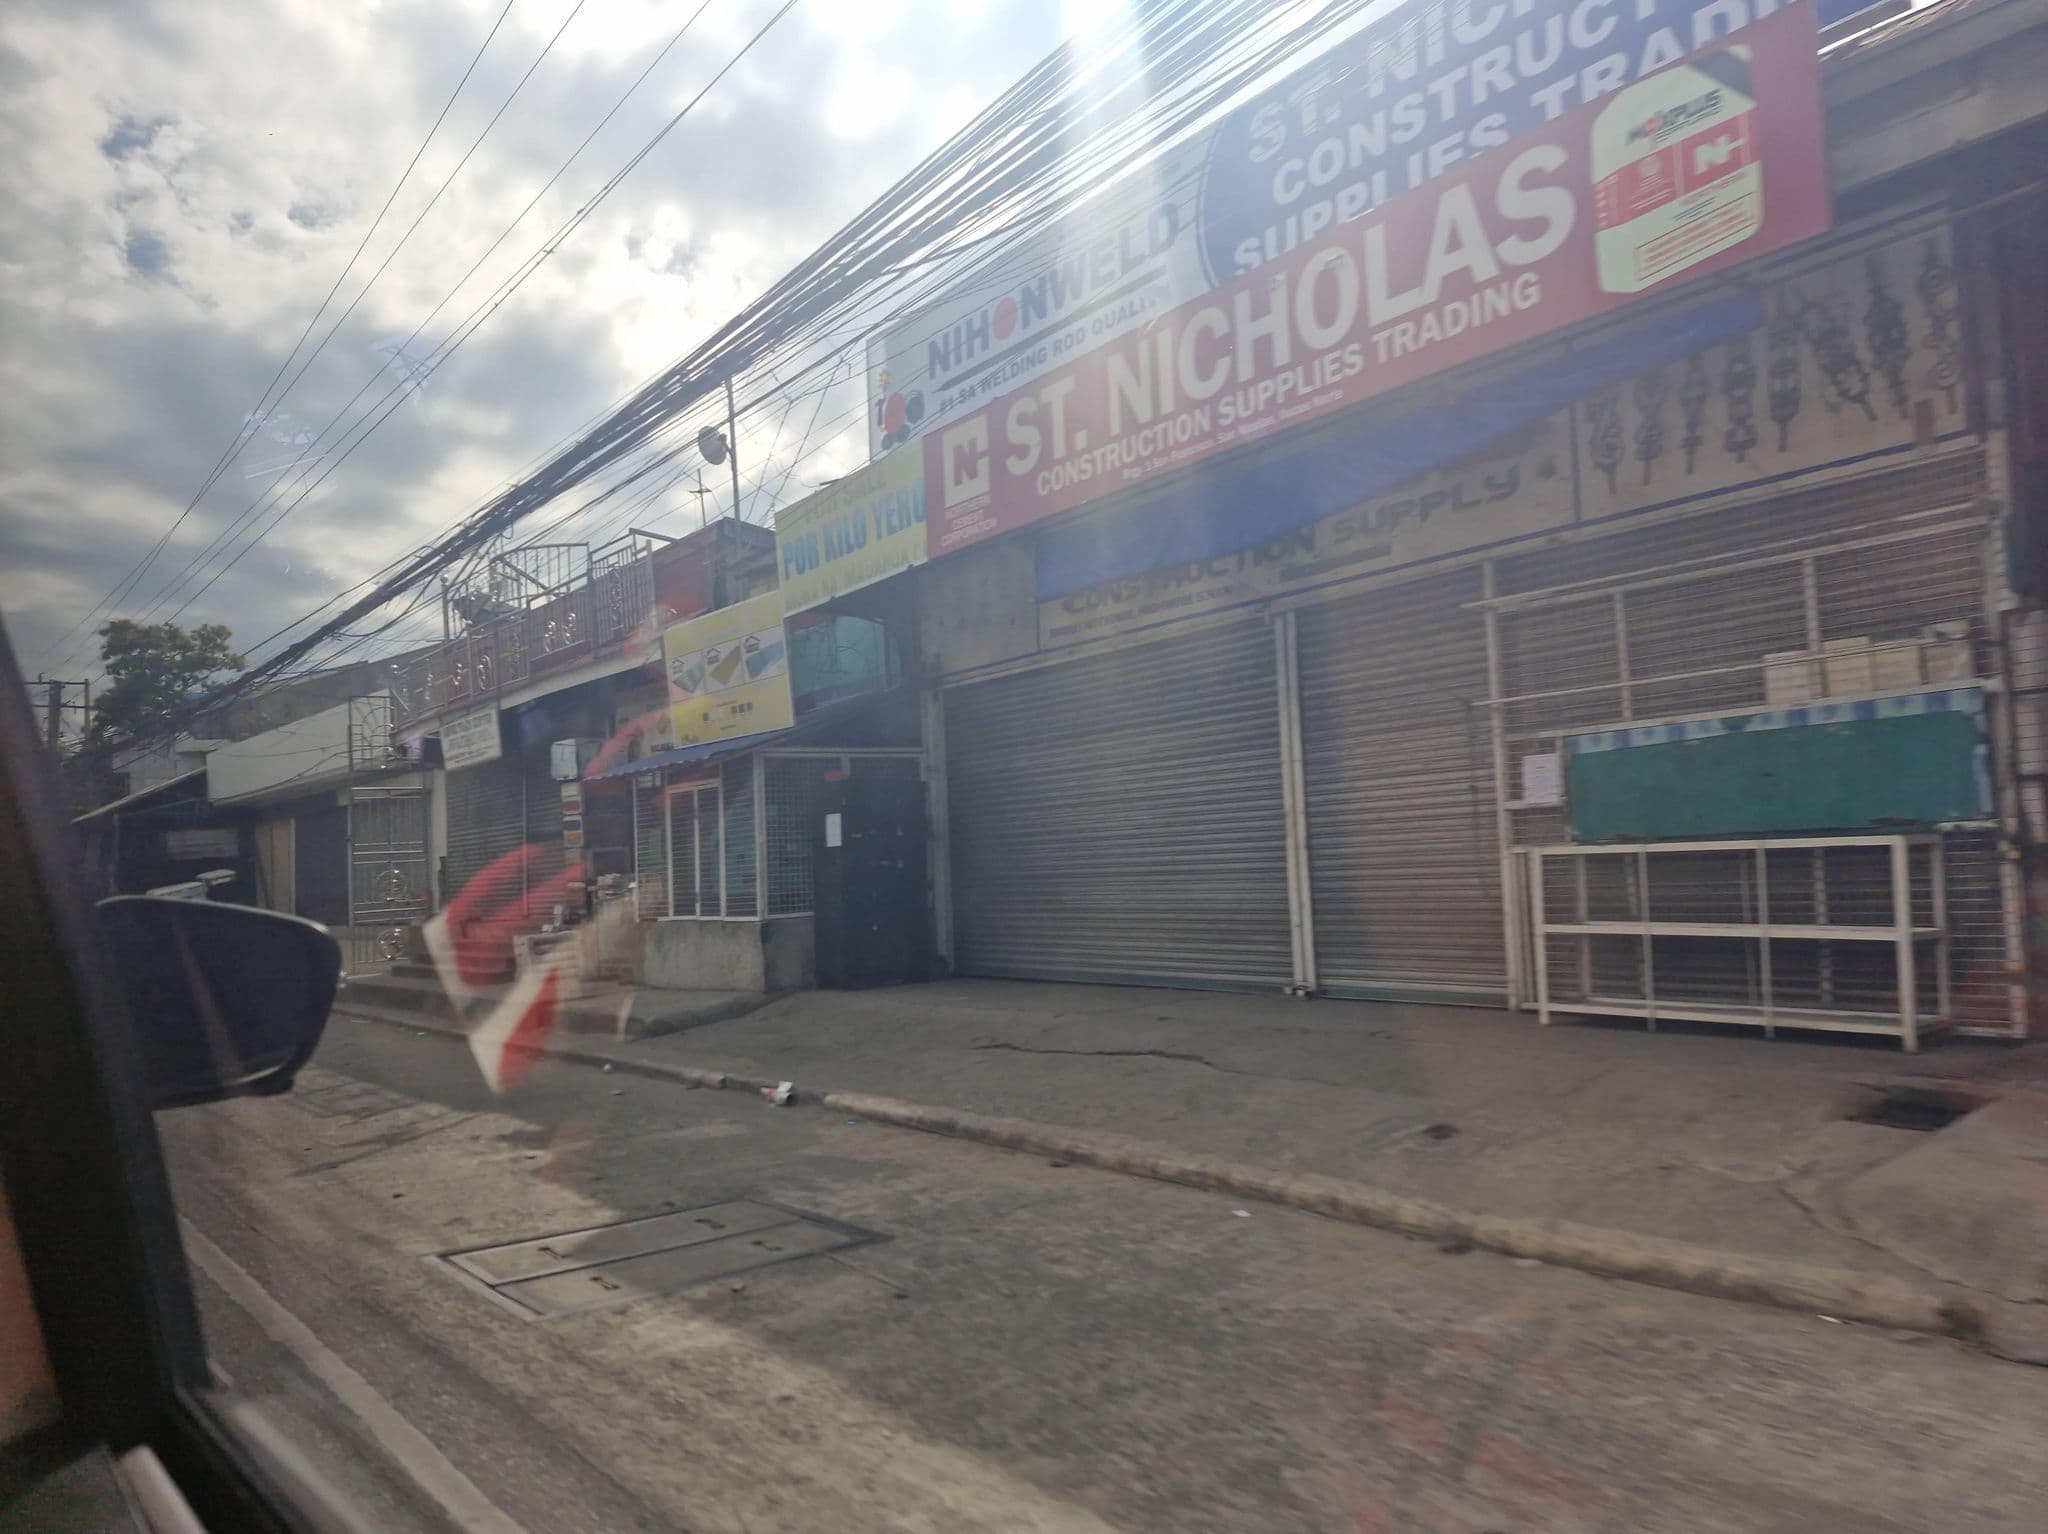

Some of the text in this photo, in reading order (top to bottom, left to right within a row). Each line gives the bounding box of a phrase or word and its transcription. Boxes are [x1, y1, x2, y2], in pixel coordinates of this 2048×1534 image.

[1368, 0, 1535, 98] NIC
[1005, 377, 1088, 475] ST.
[1107, 143, 1576, 437] NICHOLAS
[1052, 327, 1086, 358] ROD
[1037, 272, 1542, 497] CONSTRUCTION SUPPLIES TRADING
[1332, 462, 1522, 543] SUPPLY
